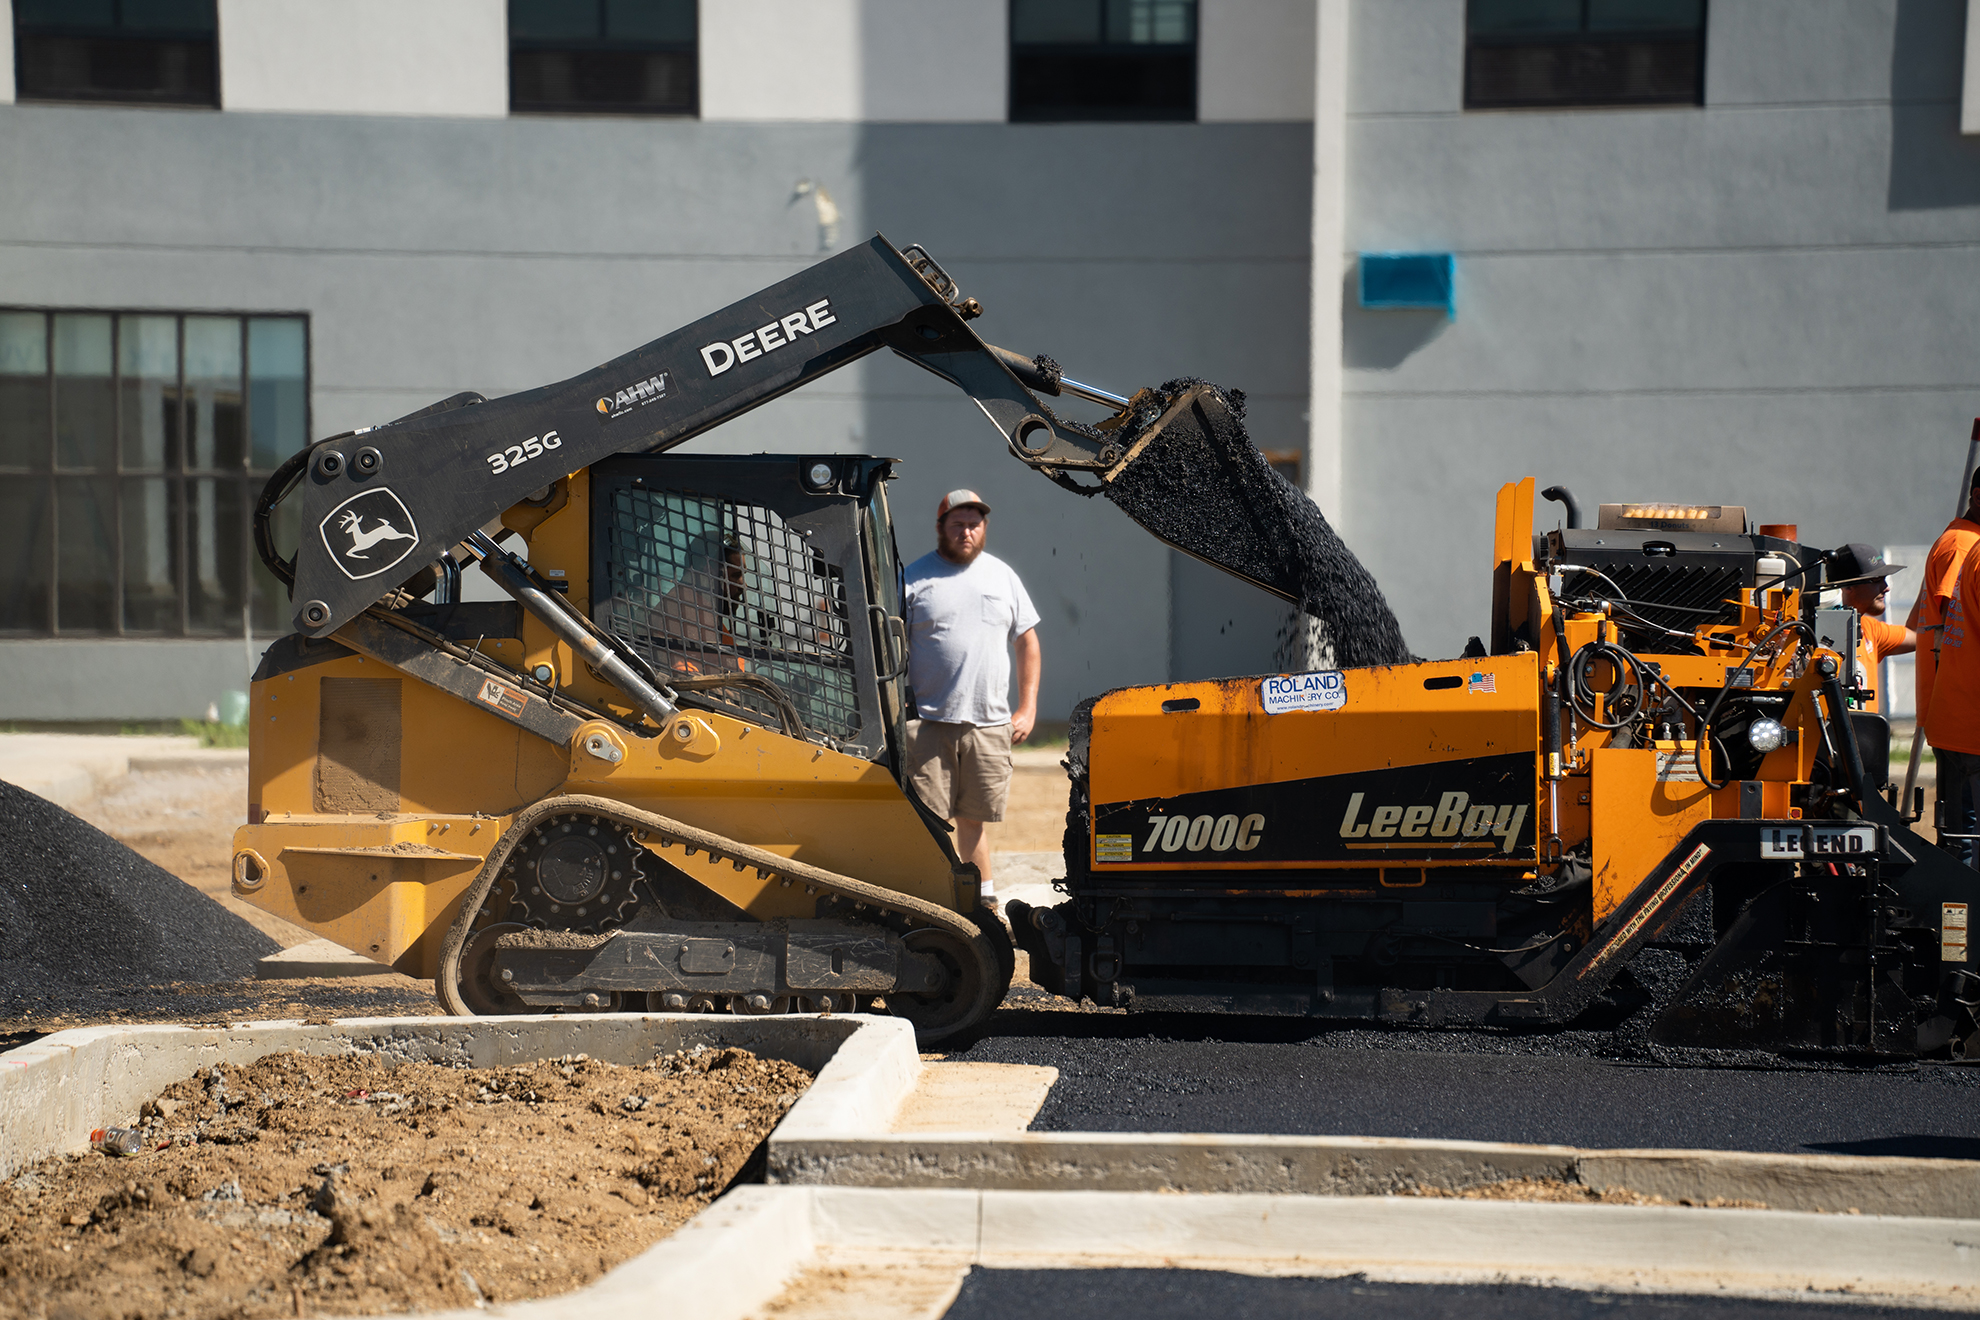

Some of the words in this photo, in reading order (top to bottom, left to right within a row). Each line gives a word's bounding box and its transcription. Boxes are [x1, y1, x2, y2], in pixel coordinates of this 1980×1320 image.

[700, 299, 836, 377] DEERE
[615, 373, 666, 410] AHW
[487, 430, 562, 475] 325G
[1661, 521, 1690, 530] Donuts
[1269, 675, 1339, 694] ROLAND
[1142, 813, 1265, 852] 7000C
[1339, 791, 1529, 854] LeeBoy
[1772, 829, 1863, 853] LEEND
[1636, 912, 1646, 924] THE
[1643, 897, 1660, 916] PAVING
[1657, 867, 1687, 901] PROFESSIONA
[1684, 861, 1692, 871] IN
